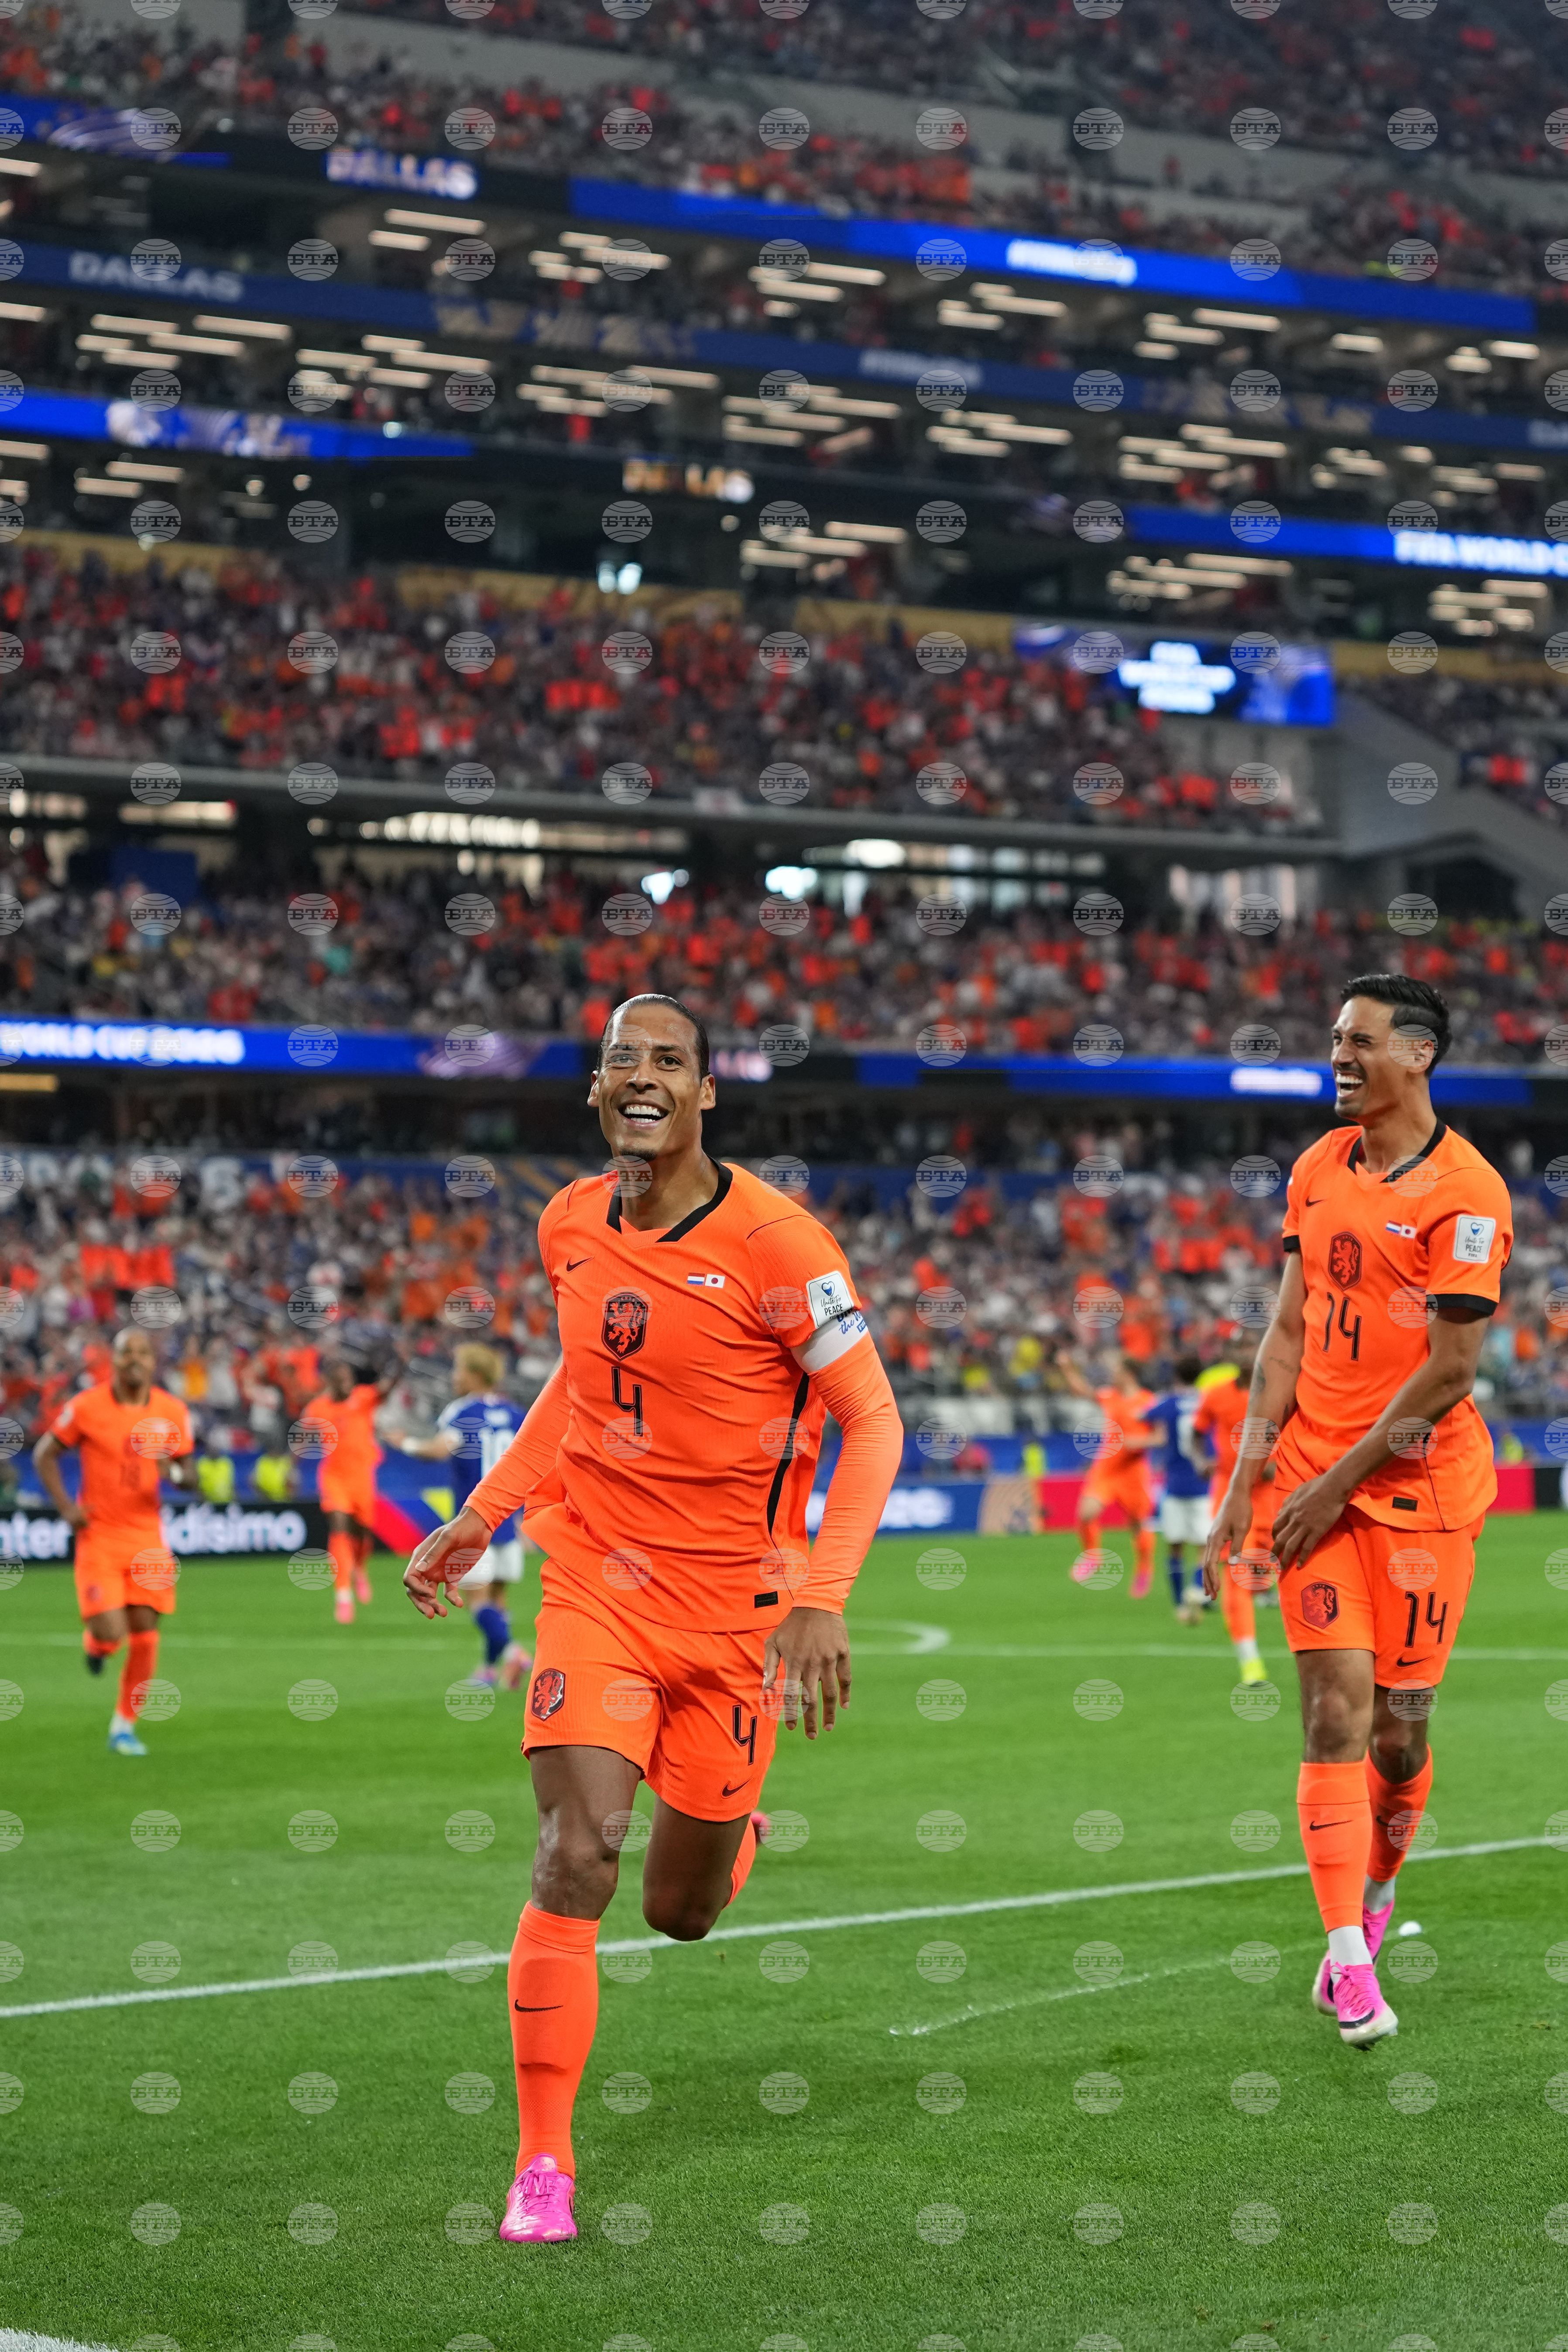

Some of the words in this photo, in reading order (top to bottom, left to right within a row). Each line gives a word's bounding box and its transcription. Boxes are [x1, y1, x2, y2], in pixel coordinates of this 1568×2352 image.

[70, 251, 244, 302] DALLAS
[1466, 1244, 1482, 1253] PEACE
[820, 1297, 835, 1308] Unite
[824, 1304, 843, 1316] PEACE
[1322, 1292, 1362, 1361] 14
[611, 1366, 643, 1437] 4
[1405, 1591, 1448, 1648] 14
[732, 1704, 758, 1766] 4
